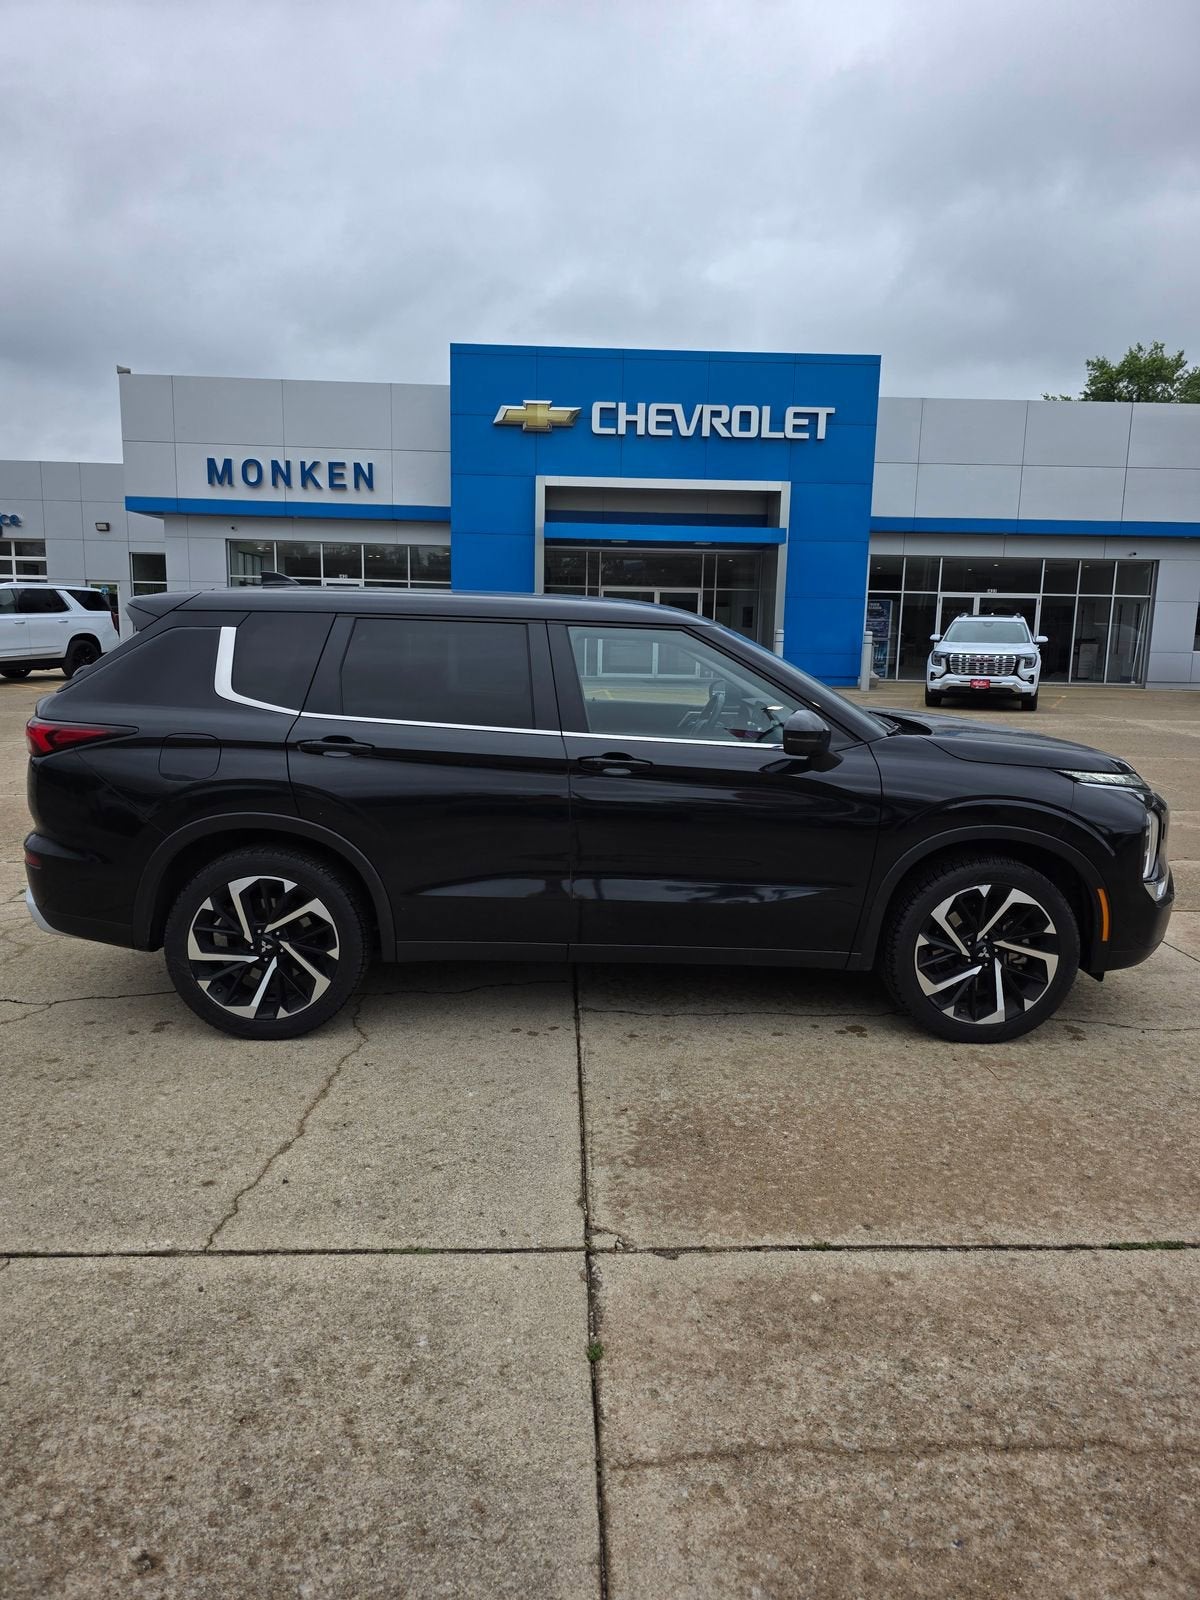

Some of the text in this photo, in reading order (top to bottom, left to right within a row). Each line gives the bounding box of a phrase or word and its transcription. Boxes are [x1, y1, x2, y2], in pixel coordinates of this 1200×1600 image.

[591, 401, 836, 440] CHEVROLET
[207, 457, 374, 490] MONKEN
[0, 513, 22, 528] ce
